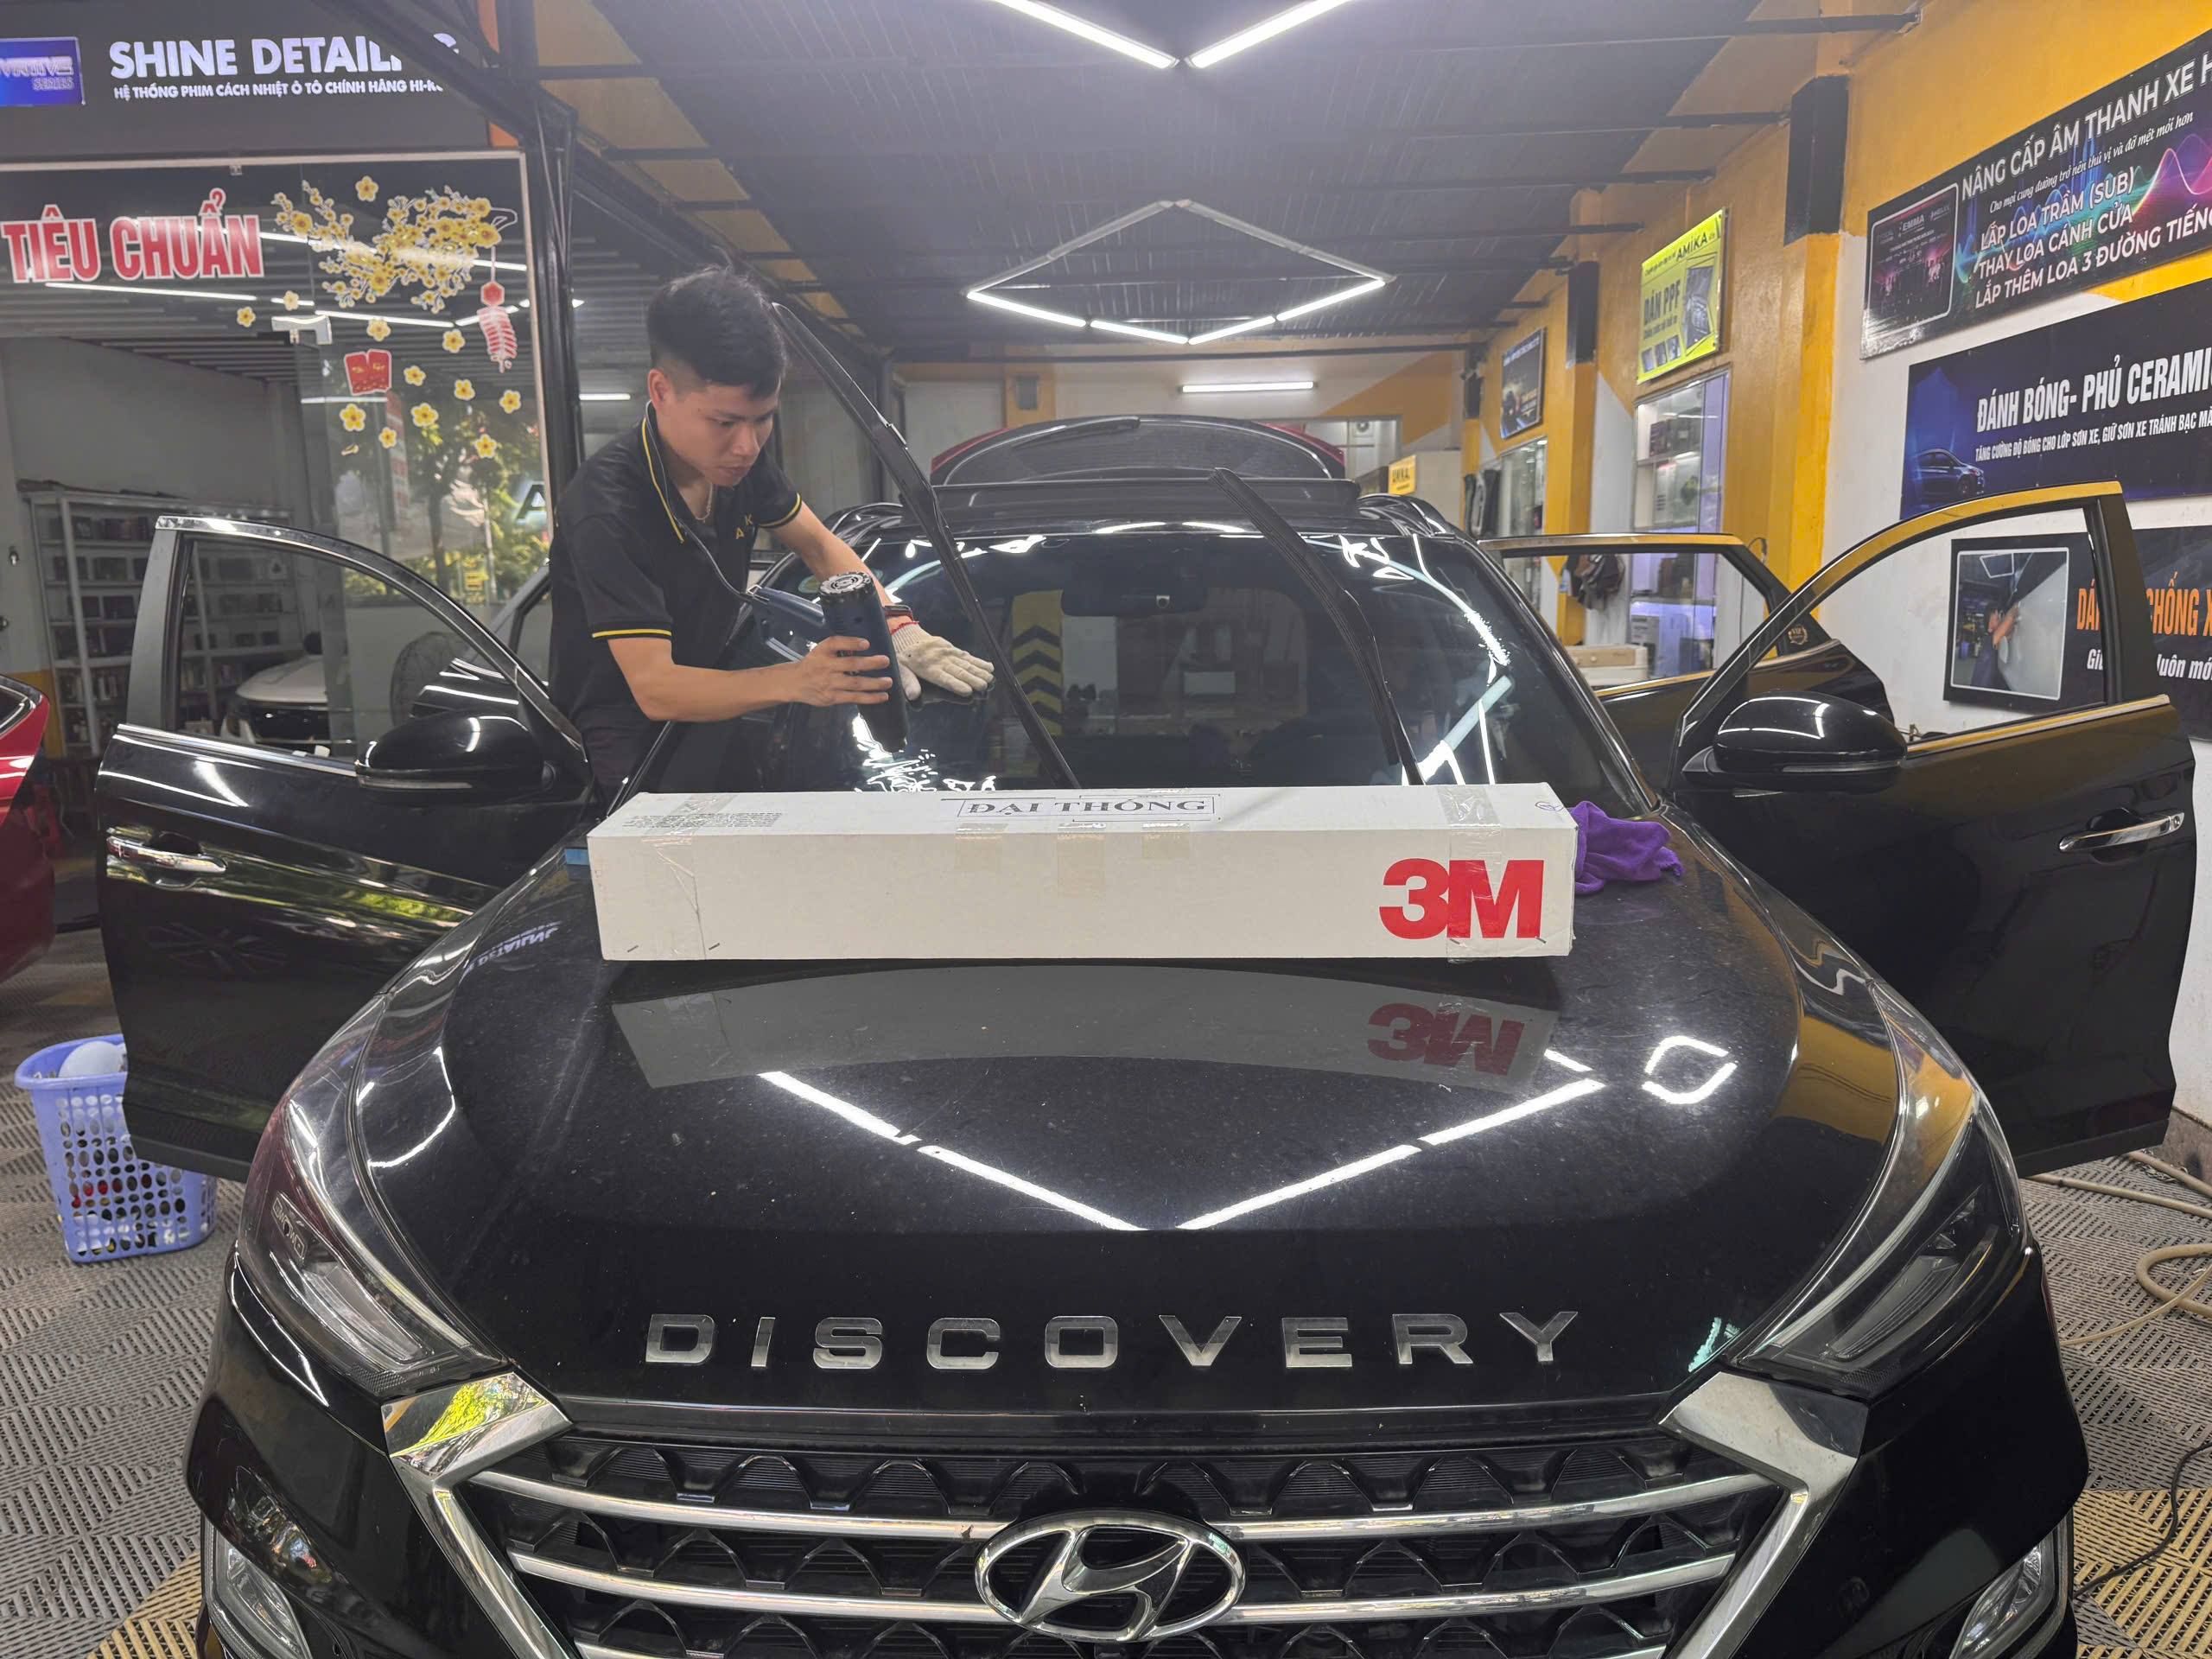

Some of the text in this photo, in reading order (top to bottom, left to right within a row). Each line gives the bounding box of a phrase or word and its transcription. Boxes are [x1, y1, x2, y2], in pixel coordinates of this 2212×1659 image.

[110, 33, 459, 79] SHINE DETAIL
[114, 84, 130, 101] HỆ
[132, 82, 178, 99] THỐNG
[181, 85, 213, 98] PHIM
[216, 80, 250, 97] CÁCH
[253, 80, 289, 98] NHIỆT
[291, 79, 302, 95] Ô
[304, 79, 323, 95] TÔ
[325, 78, 365, 94] CHÍNH
[1962, 158, 2005, 200] NÂNG
[2011, 133, 2045, 177] CẤP
[2050, 119, 2080, 159] ÂM
[2085, 79, 2159, 140] THANH
[2164, 60, 2195, 103] XE
[1990, 200, 2002, 213] Cho
[2004, 192, 2016, 207] mọi
[2018, 186, 2033, 200] cung
[2035, 175, 2057, 193] đường
[2072, 161, 2086, 175] nên
[2088, 152, 2101, 168] thú
[2104, 147, 2111, 162] vị
[2113, 142, 2123, 157] và
[2126, 135, 2137, 152] đỡ
[2138, 129, 2155, 145] mệt
[2156, 116, 2174, 137] mỏi
[2175, 111, 2194, 129] hơn
[1, 188, 264, 283] TIÊU CHUẨN
[1979, 201, 2133, 280] THAY LOA CÁNH CỬA
[1980, 166, 2134, 251] LẮP LOA TRẦM (SUB)
[1975, 279, 2000, 308] LẮP
[2005, 265, 2042, 298] THÊM
[2047, 257, 2078, 283] LOA
[2082, 251, 2091, 272] 3
[2096, 226, 2161, 267] ĐƯỜNG
[1977, 346, 2212, 433] ĐÁNH BÓNG- PHỦ CERAMI
[2023, 436, 2041, 454] BÓNG
[2042, 435, 2056, 451] CHO
[2072, 429, 2088, 448] SƠN
[2102, 423, 2117, 442] GIỮ
[2117, 422, 2134, 440] SƠN
[2135, 421, 2147, 437] XE
[2149, 414, 2177, 435] TRÁNH
[2178, 412, 2196, 434] BẠC
[969, 802, 1040, 815] ĐẠI
[1379, 858, 1544, 940] 3M
[645, 1312, 1579, 1370] DISCOVERY
